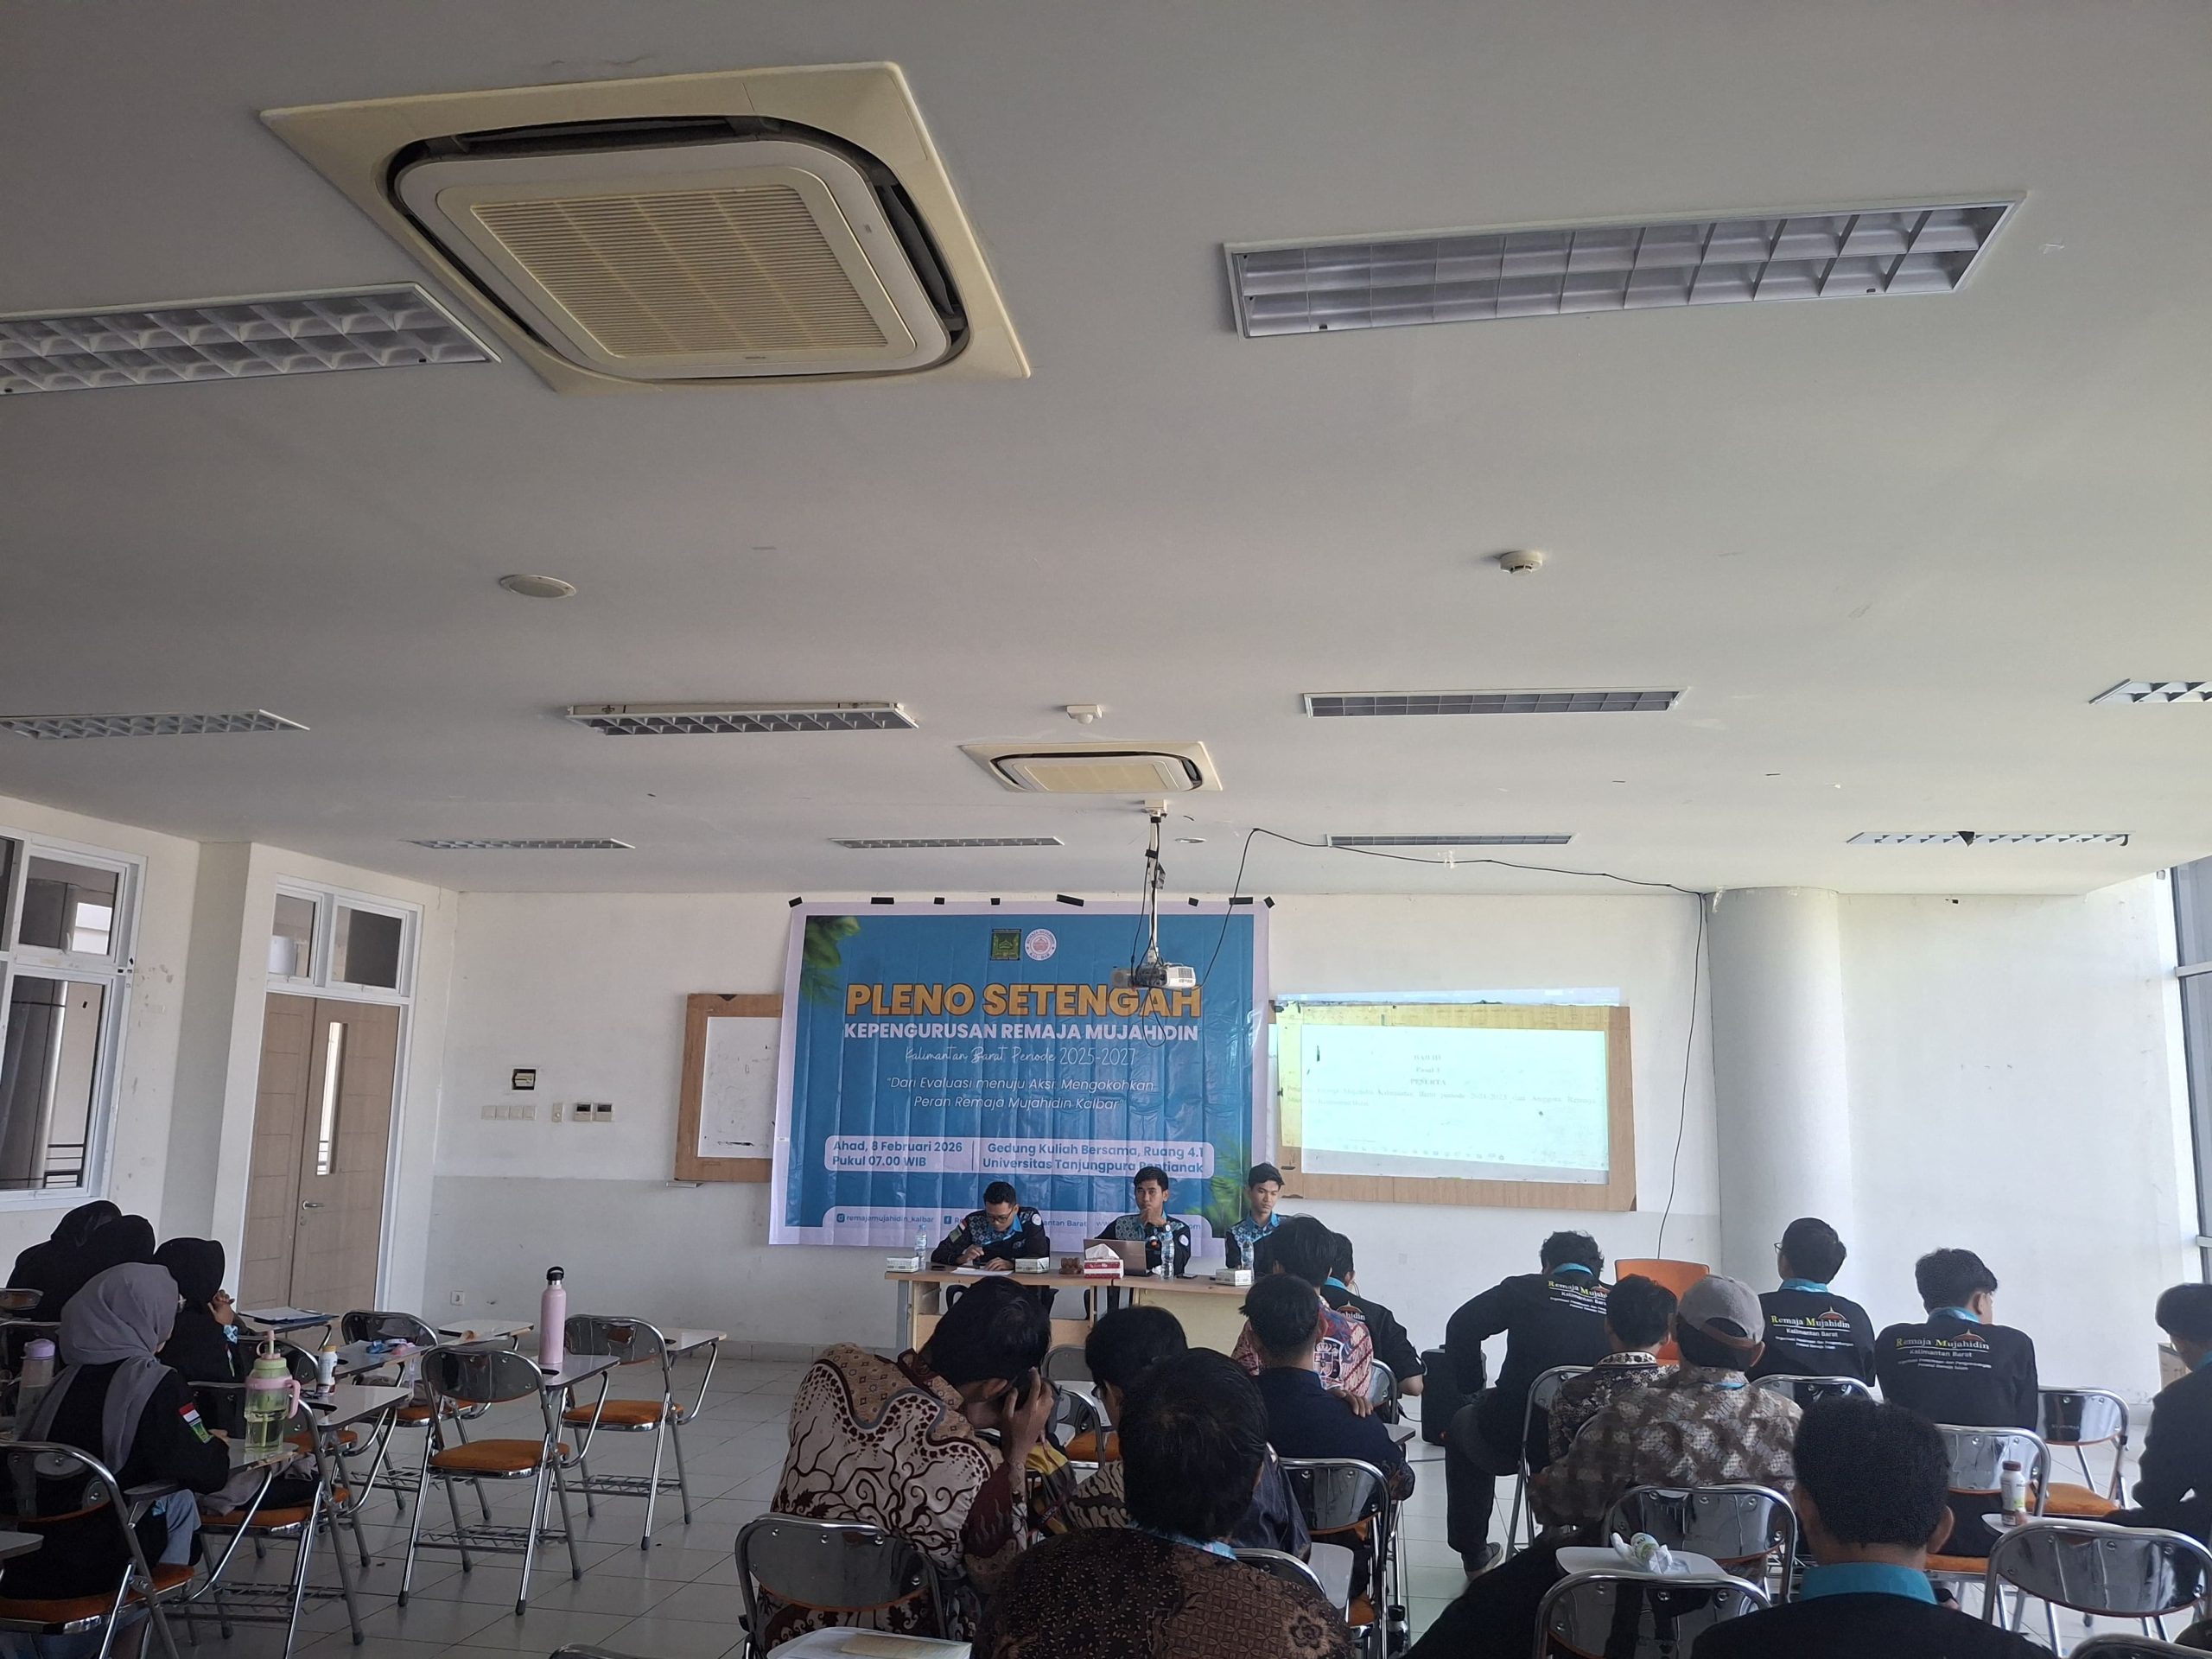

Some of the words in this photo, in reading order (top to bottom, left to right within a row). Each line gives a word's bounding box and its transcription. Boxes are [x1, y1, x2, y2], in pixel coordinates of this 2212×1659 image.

[845, 983, 976, 1016] PLENO
[982, 983, 1202, 1018] SETENGAH
[844, 1022, 997, 1039] KEPENGURUSAN
[1001, 1023, 1082, 1040] REMAJA
[1085, 1025, 1198, 1042] MUJAHIDIN
[905, 1046, 968, 1063] Kalimantan
[970, 1046, 1008, 1064] Barat
[1011, 1046, 1056, 1064] Periode
[1059, 1046, 1135, 1065] 2025-2027
[919, 1077, 972, 1088] Evaluasi
[976, 1078, 1025, 1092] menuju
[1061, 1078, 1154, 1093] Mengokohkan
[913, 1096, 950, 1107] Peran
[955, 1097, 1005, 1110] Remaja
[1007, 1097, 1071, 1110] Mujahidin
[834, 1141, 868, 1152] Ahad,
[871, 1142, 878, 1151] 8
[880, 1141, 931, 1152] Februari
[934, 1142, 963, 1152] 2026
[988, 1143, 1036, 1156] Gedung
[1039, 1143, 1078, 1154] Kuliah
[1081, 1145, 1141, 1157] Bersama,
[1143, 1147, 1185, 1160] Ruang
[1187, 1147, 1204, 1158] 4.1
[832, 1156, 866, 1166] Pukul
[868, 1156, 900, 1166] 07.00
[904, 1157, 926, 1166] WIB
[982, 1158, 1052, 1169] Universitas
[1054, 1160, 1136, 1173] Tanjungpura
[1548, 1281, 1580, 1292] Remaja
[1771, 1315, 1803, 1326] Remaja
[1806, 1317, 1850, 1329] Mujahidin
[1896, 1338, 1931, 1347] Remaja
[1936, 1338, 1990, 1350] Mujahidin
